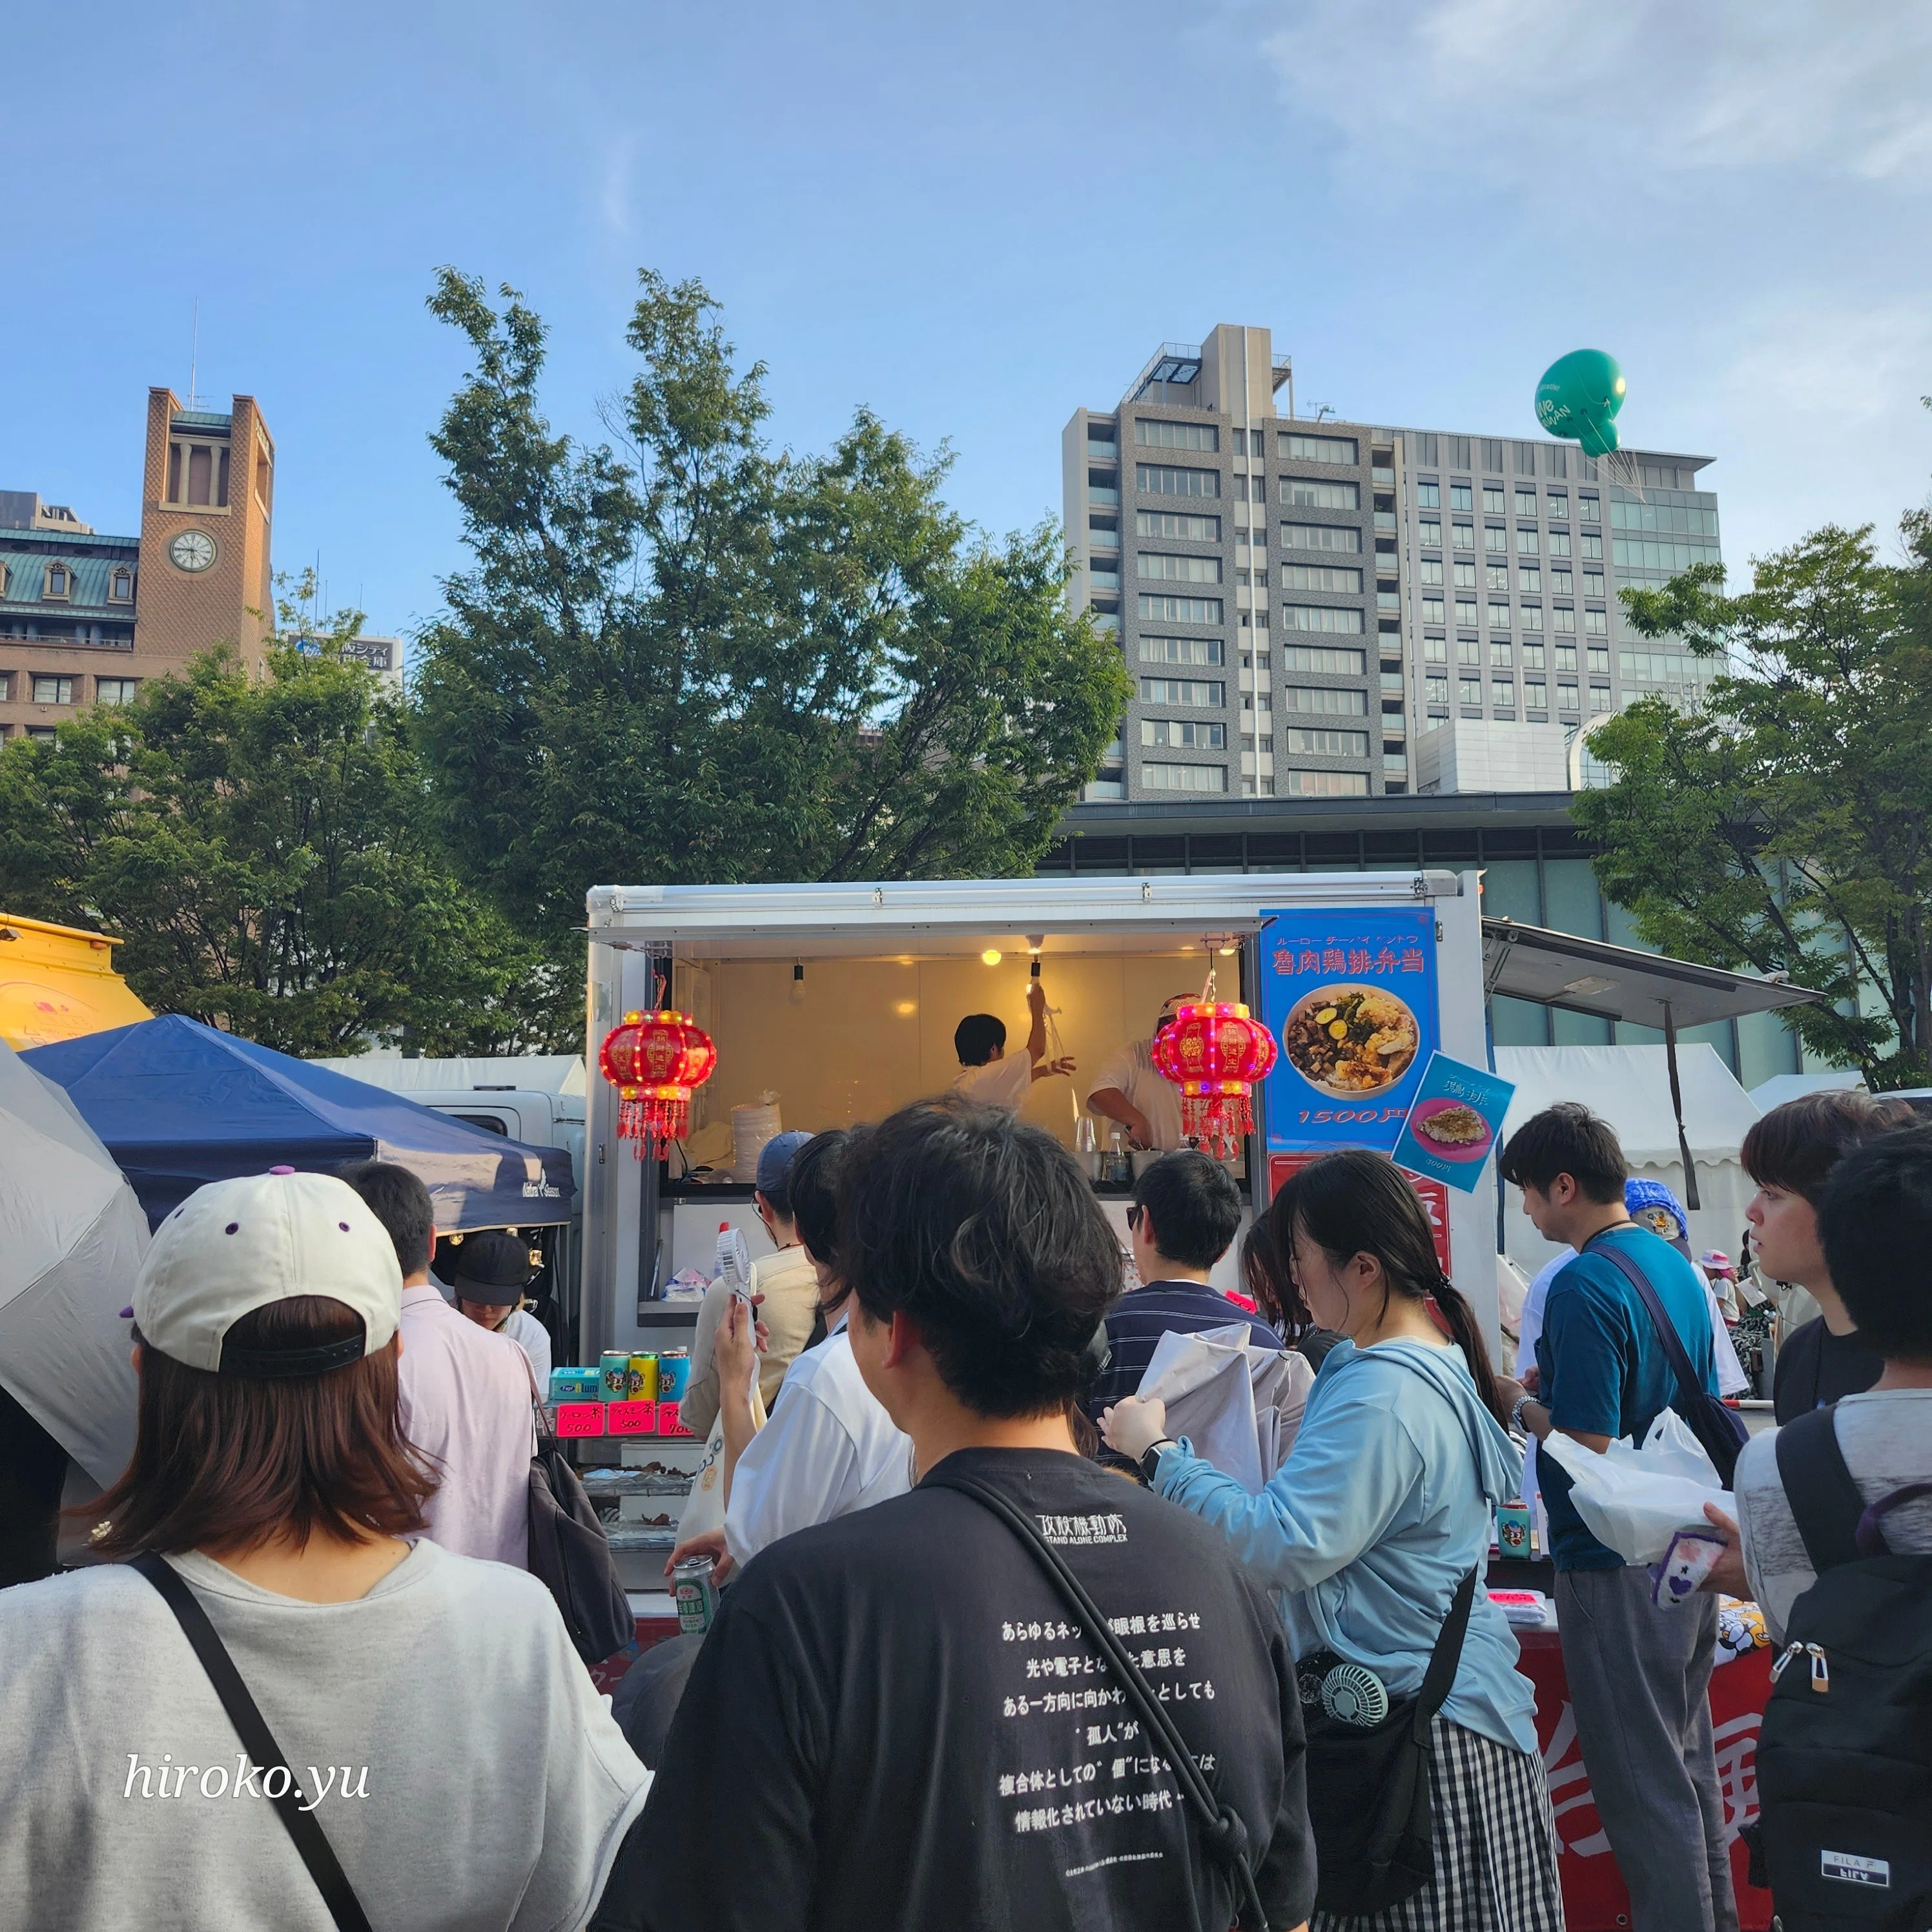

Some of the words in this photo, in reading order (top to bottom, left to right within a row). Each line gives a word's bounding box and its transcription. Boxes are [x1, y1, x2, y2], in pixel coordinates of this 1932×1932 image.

[1542, 404, 1571, 429] AIWAN
[341, 642, 388, 657] 阪シティ
[1272, 947, 1424, 975] 魯肉鶏排弁当
[1299, 1107, 1409, 1124] 1500円
[575, 1382, 599, 1393] Alum
[567, 1423, 592, 1433] 500
[621, 1419, 642, 1428] 500
[1069, 1536, 1093, 1545] ALONE
[1093, 1534, 1129, 1544] COMPLEX
[1833, 1855, 1860, 1867] FILA
